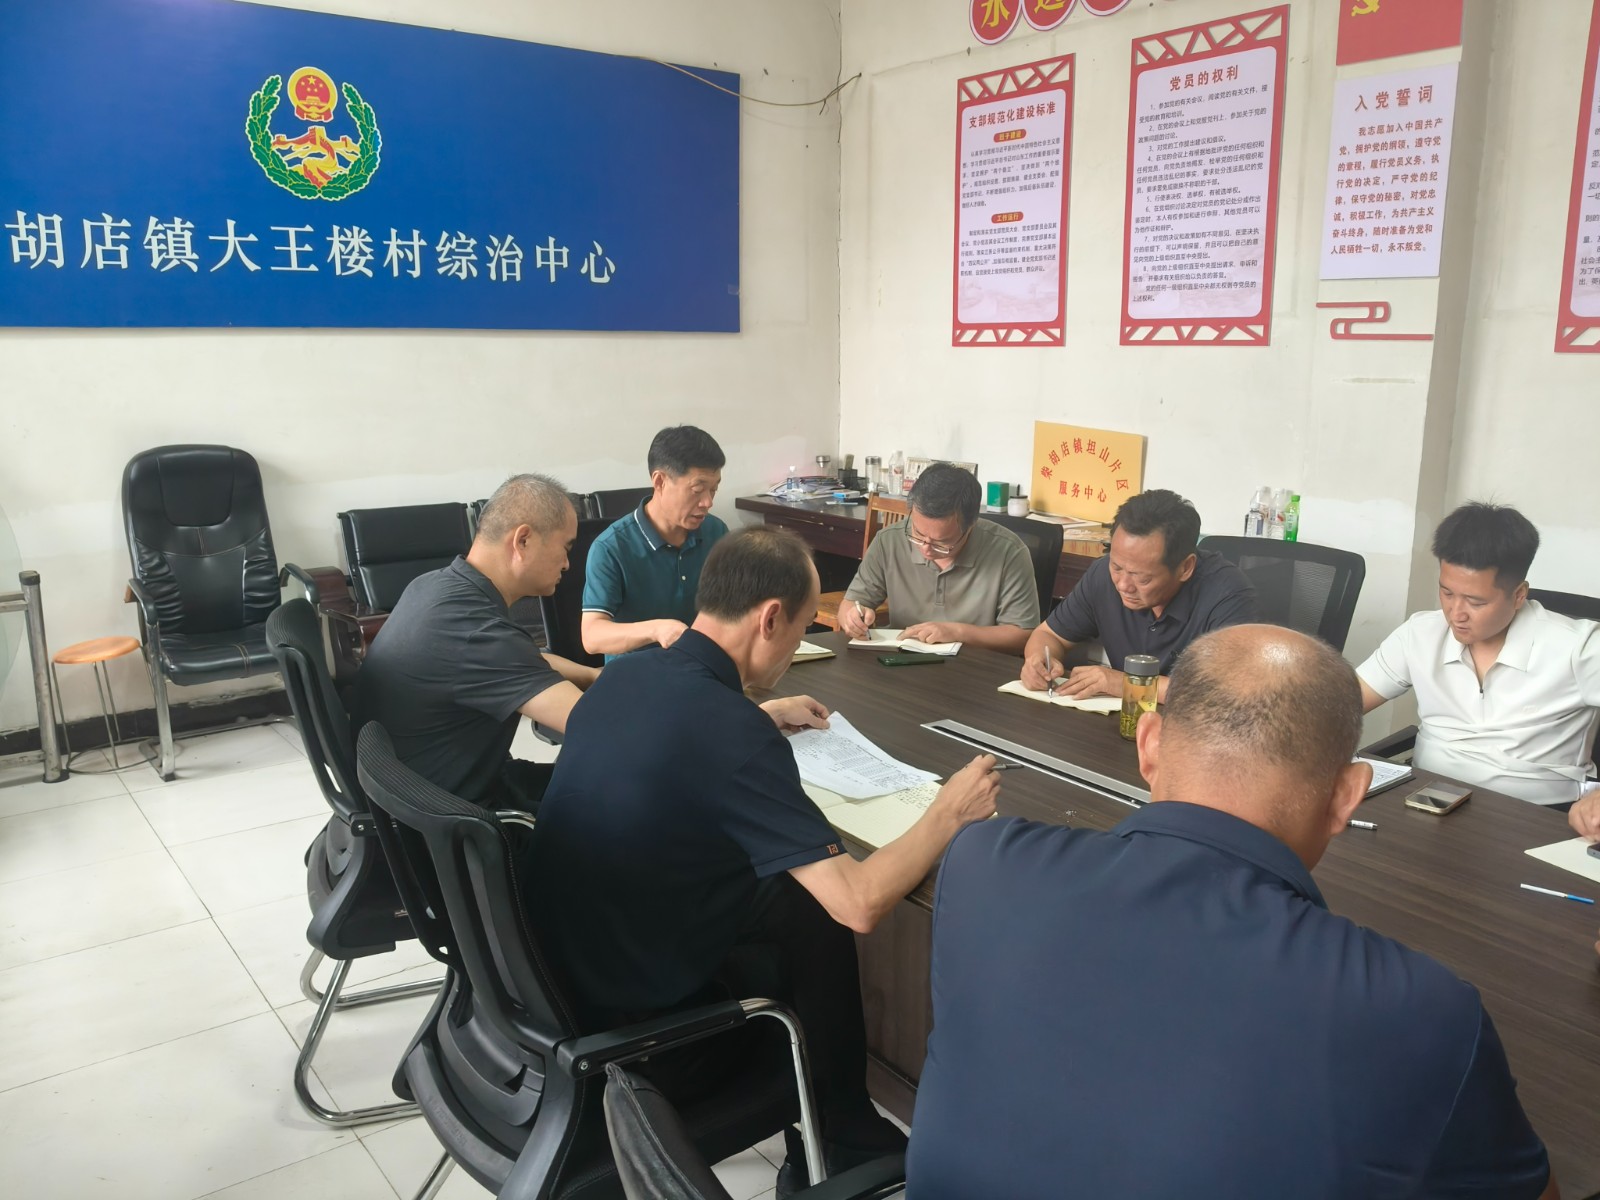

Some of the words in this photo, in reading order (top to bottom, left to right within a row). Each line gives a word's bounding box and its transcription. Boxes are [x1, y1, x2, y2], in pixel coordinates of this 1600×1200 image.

[1169, 64, 1238, 91] 党员的权利
[1355, 85, 1433, 112] 入党誓词
[969, 100, 1055, 128] 支部规范化建设标准
[1358, 118, 1443, 137] 我志愿加入中国共产
[1336, 171, 1438, 189] 行党的决定，严守党的纪
[997, 212, 1018, 222] 工作运行
[5, 210, 616, 284] 胡店镇大王楼村综治中心
[1058, 480, 1107, 503] 服务中心
